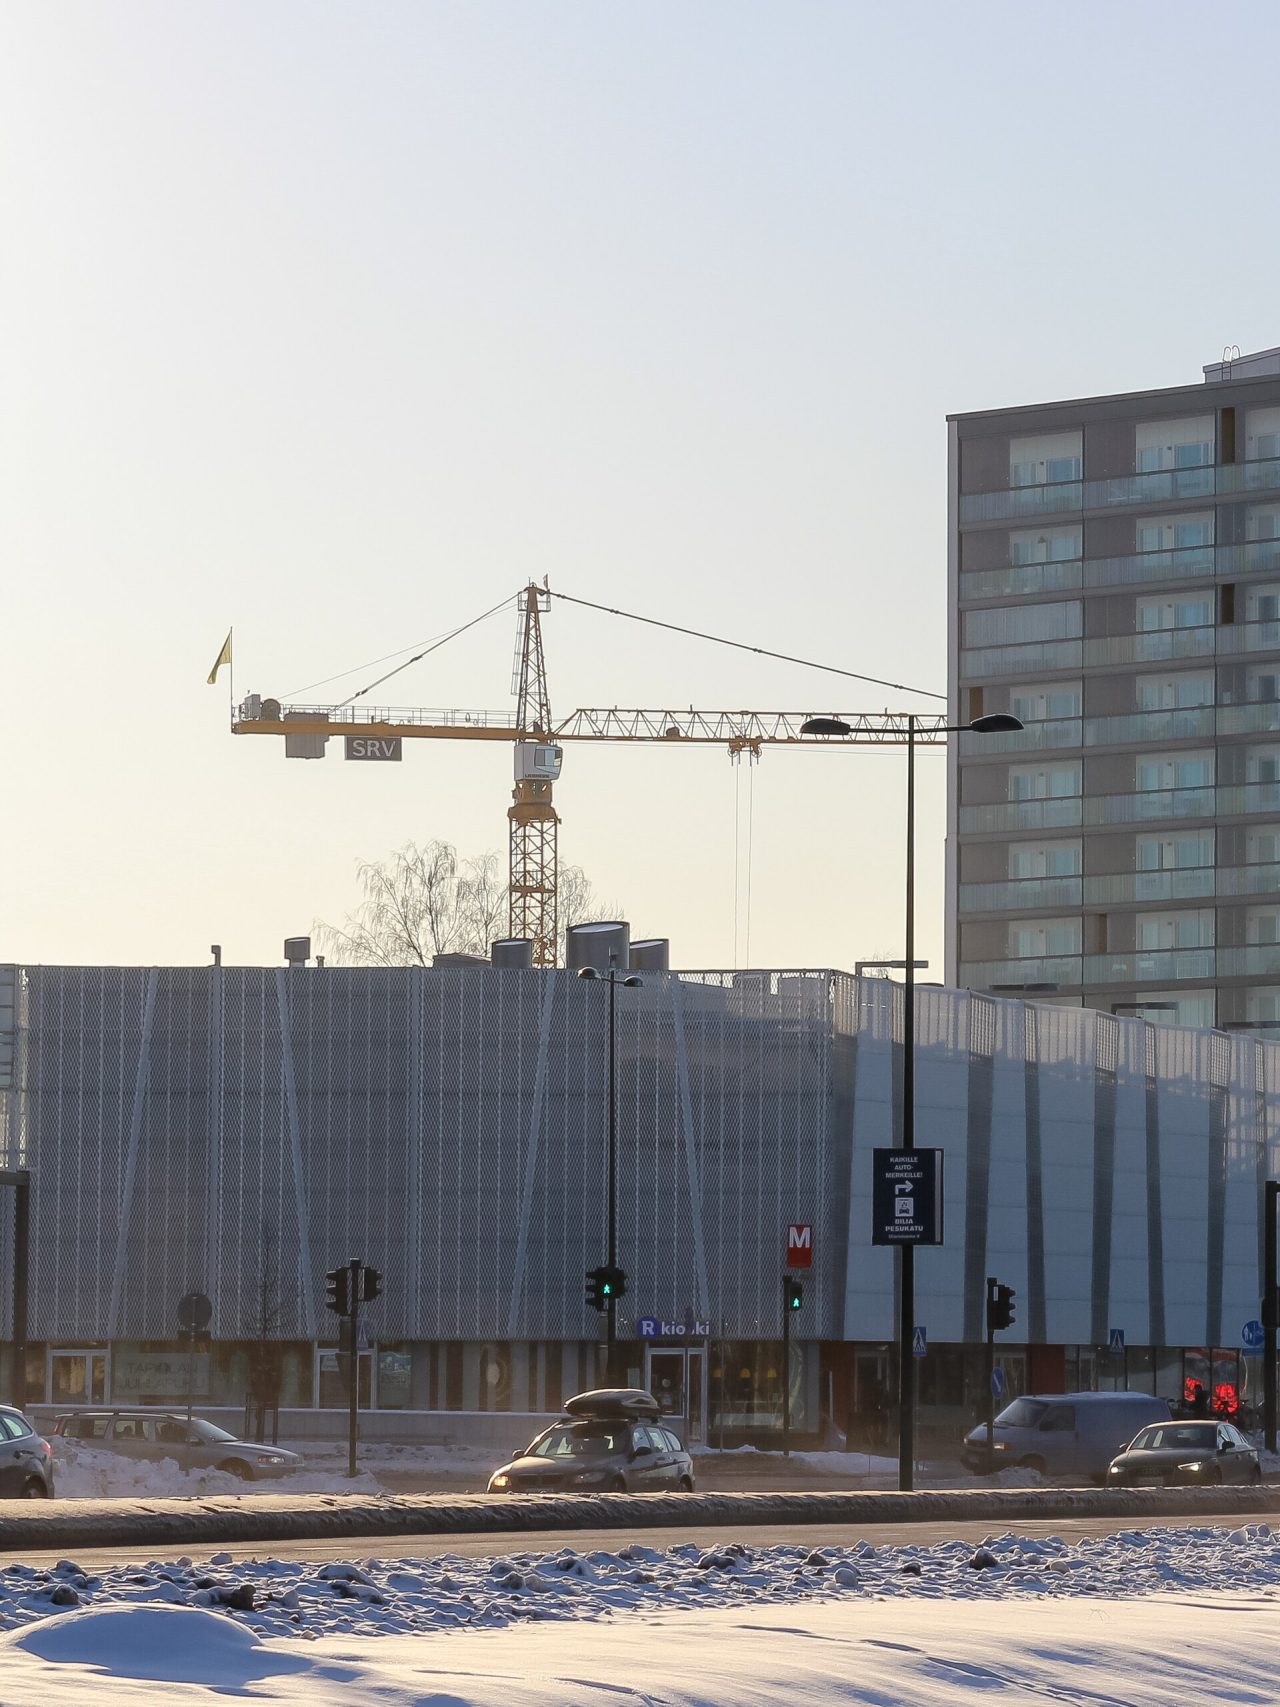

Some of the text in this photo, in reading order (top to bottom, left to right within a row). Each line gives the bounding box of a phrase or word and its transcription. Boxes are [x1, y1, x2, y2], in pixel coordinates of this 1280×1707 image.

[352, 740, 396, 757] SRV
[788, 1227, 811, 1248] M
[641, 1320, 710, 1336] R kioki
